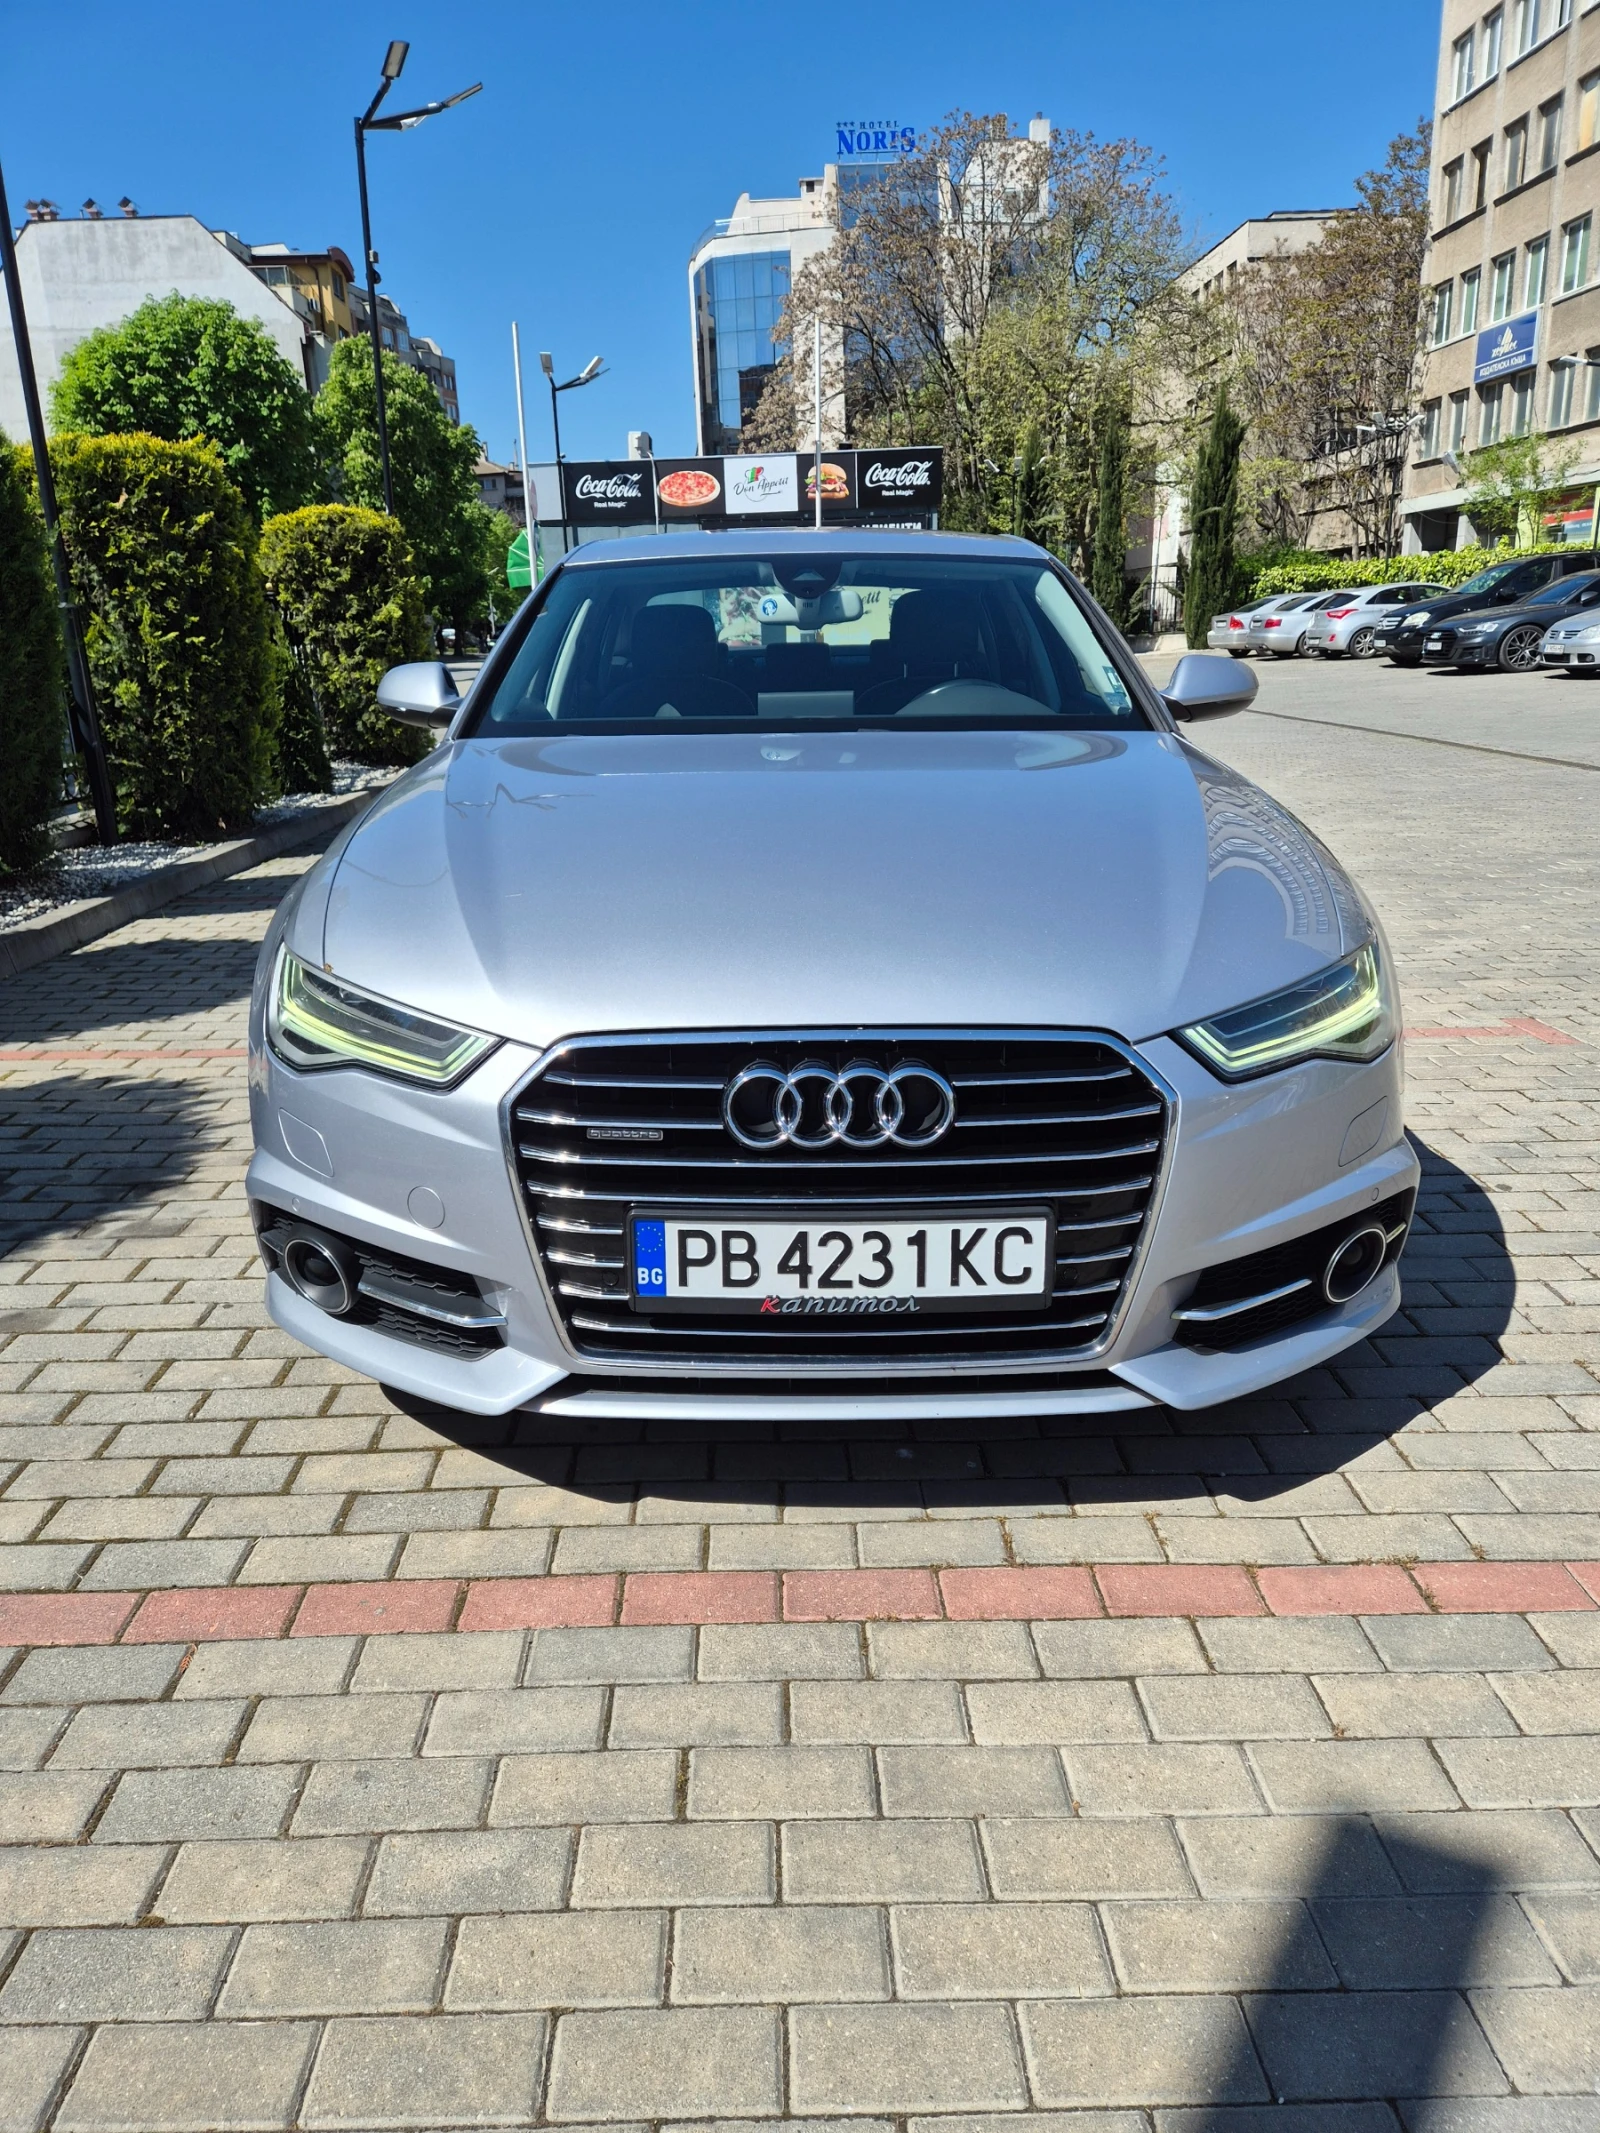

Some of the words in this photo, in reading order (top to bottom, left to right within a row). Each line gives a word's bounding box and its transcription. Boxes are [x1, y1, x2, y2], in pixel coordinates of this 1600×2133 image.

[860, 120, 900, 130] HOTEL
[836, 127, 916, 155] NORIS
[865, 461, 934, 488] Coca-Cola
[575, 473, 643, 499] Coca-Cola
[881, 489, 895, 497] Real
[895, 488, 916, 497] Magic
[607, 500, 628, 509] Magic
[590, 1129, 660, 1139] quattro
[677, 1228, 760, 1288] PB
[776, 1229, 928, 1289] 4231
[950, 1226, 1034, 1286] KC
[637, 1266, 664, 1286] BG
